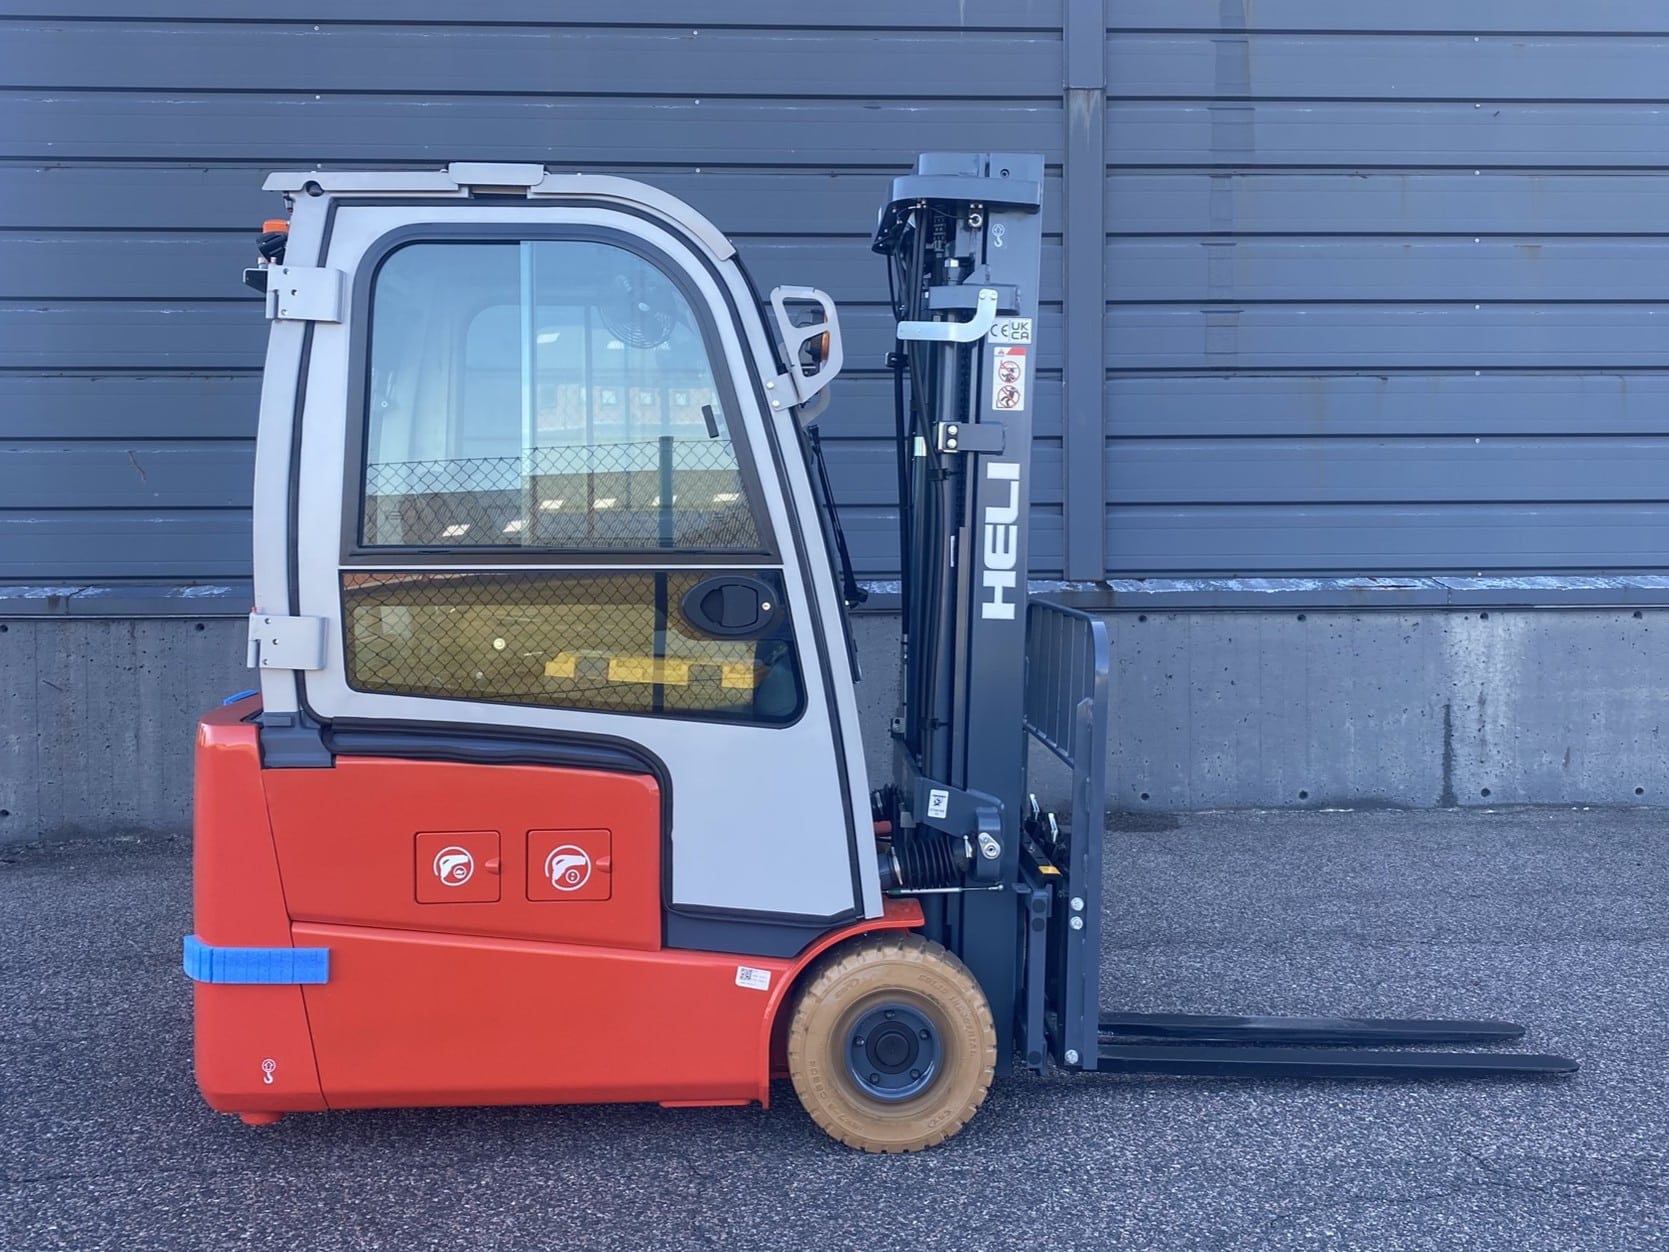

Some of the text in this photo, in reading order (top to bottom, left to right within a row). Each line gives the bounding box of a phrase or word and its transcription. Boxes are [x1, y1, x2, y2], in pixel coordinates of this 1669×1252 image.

[990, 324, 1009, 337] CE
[1011, 322, 1029, 331] UK
[1011, 331, 1029, 340] CA
[982, 462, 1020, 619] HELI
